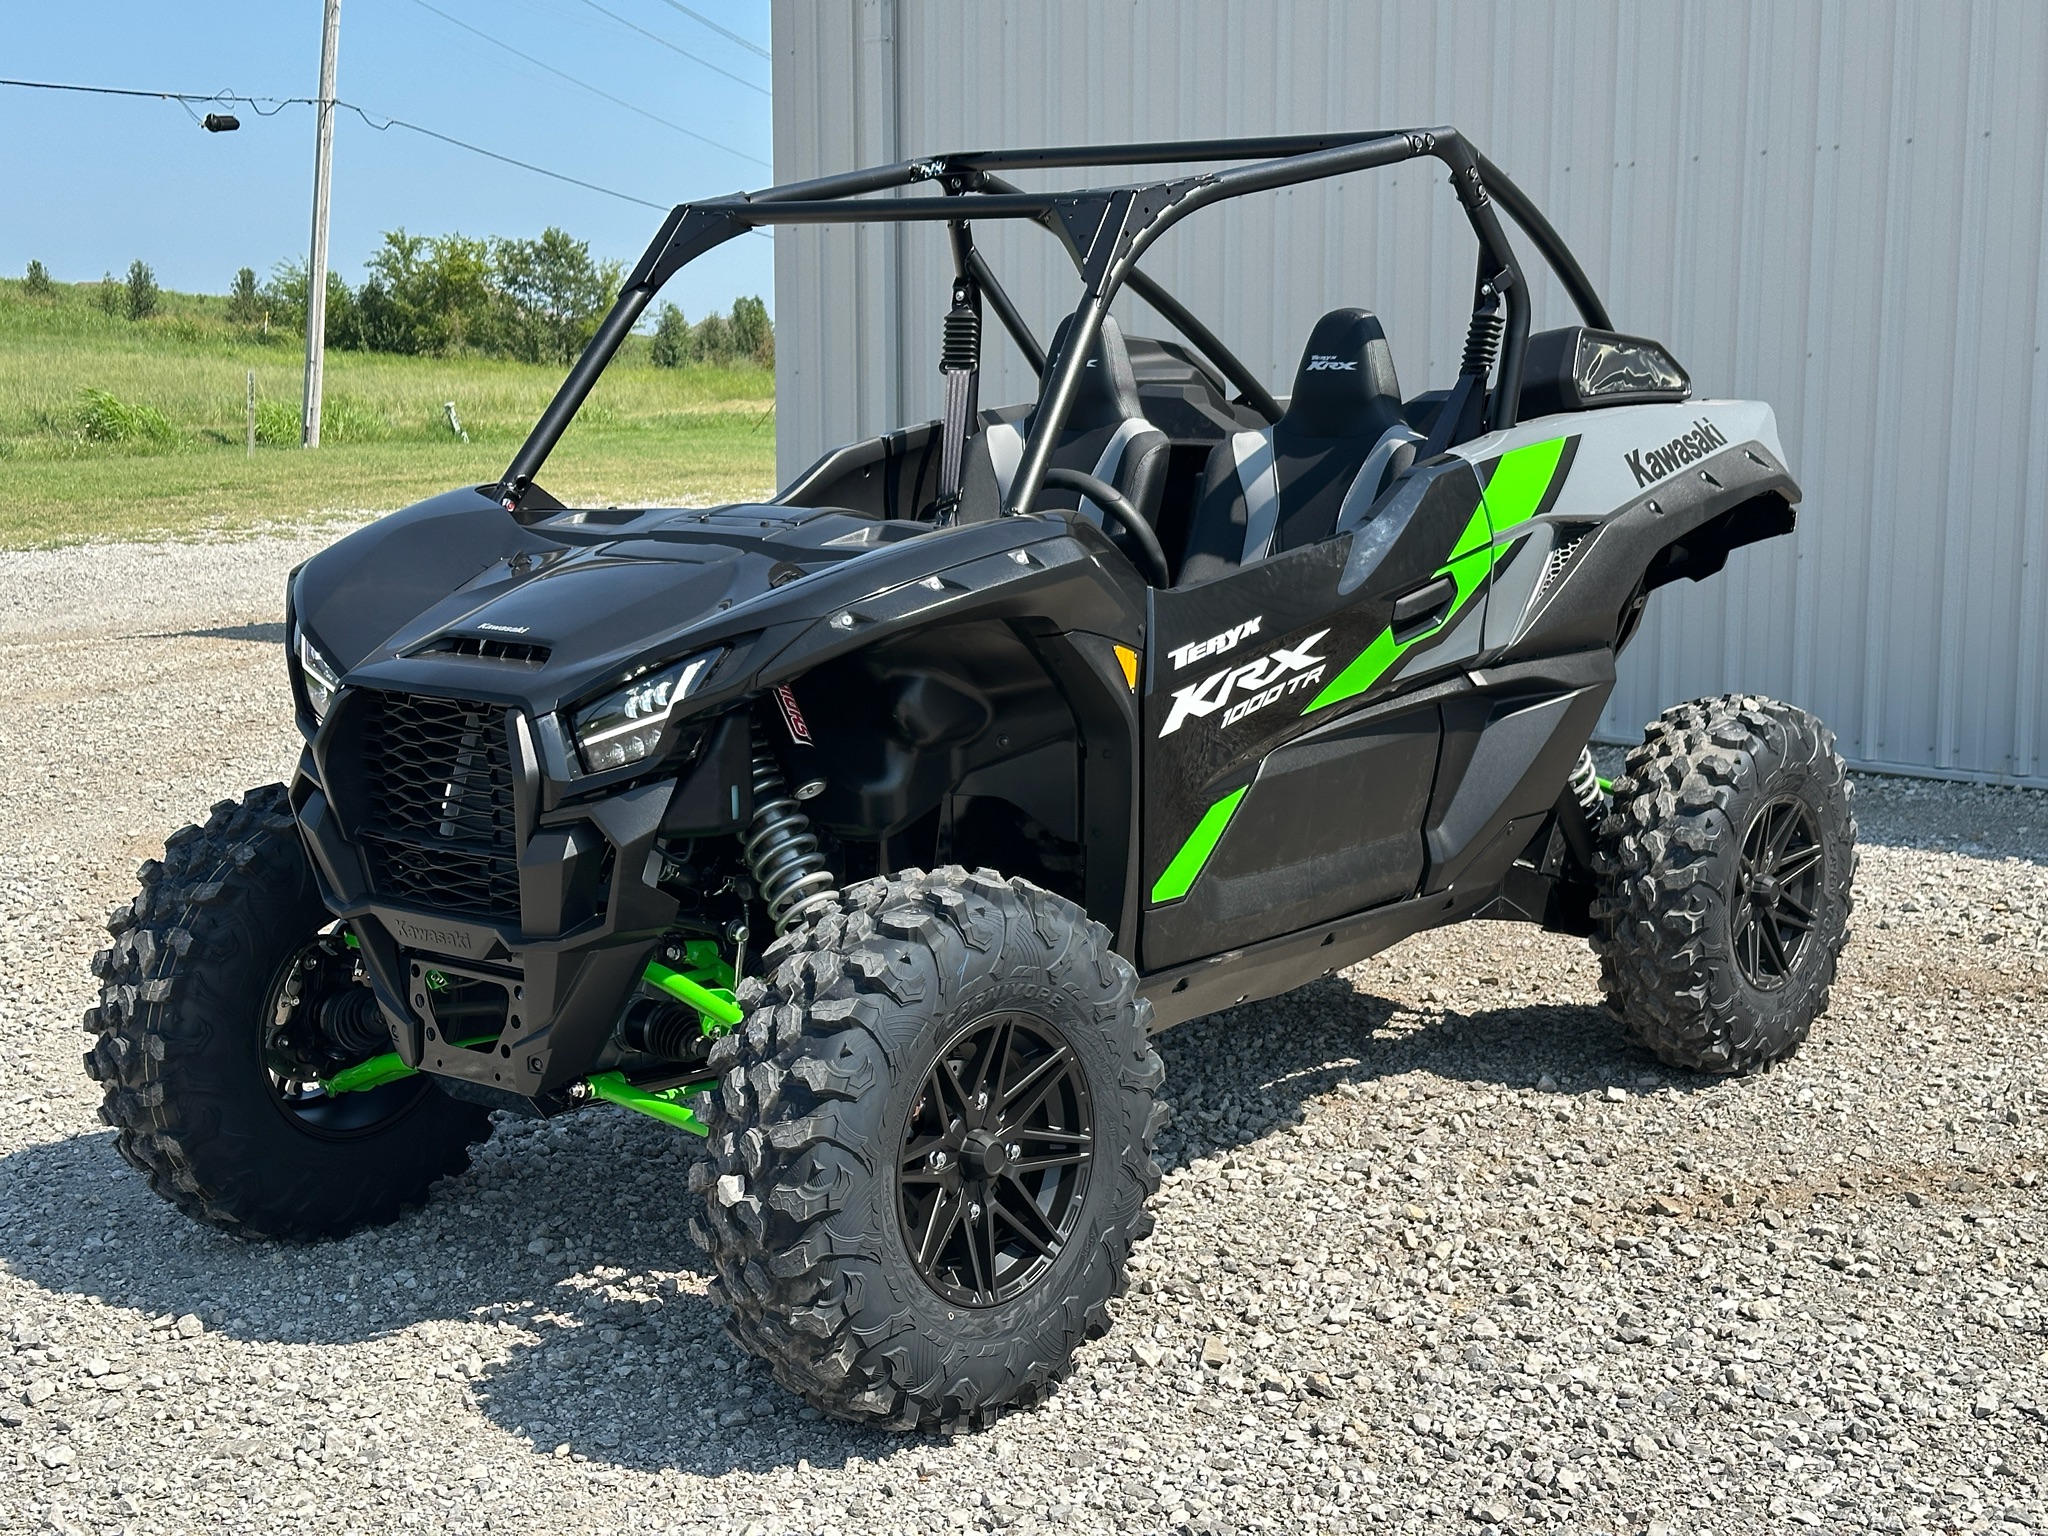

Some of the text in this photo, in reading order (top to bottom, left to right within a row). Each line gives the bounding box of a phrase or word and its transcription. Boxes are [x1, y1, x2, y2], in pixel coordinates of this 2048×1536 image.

[1305, 361, 1359, 371] KRX
[1623, 416, 1729, 489] Kawasaki
[476, 622, 530, 634] Kawasaki
[1167, 615, 1263, 671] TERYX
[1158, 627, 1331, 739] KRX
[394, 918, 472, 950] Kawasaki
